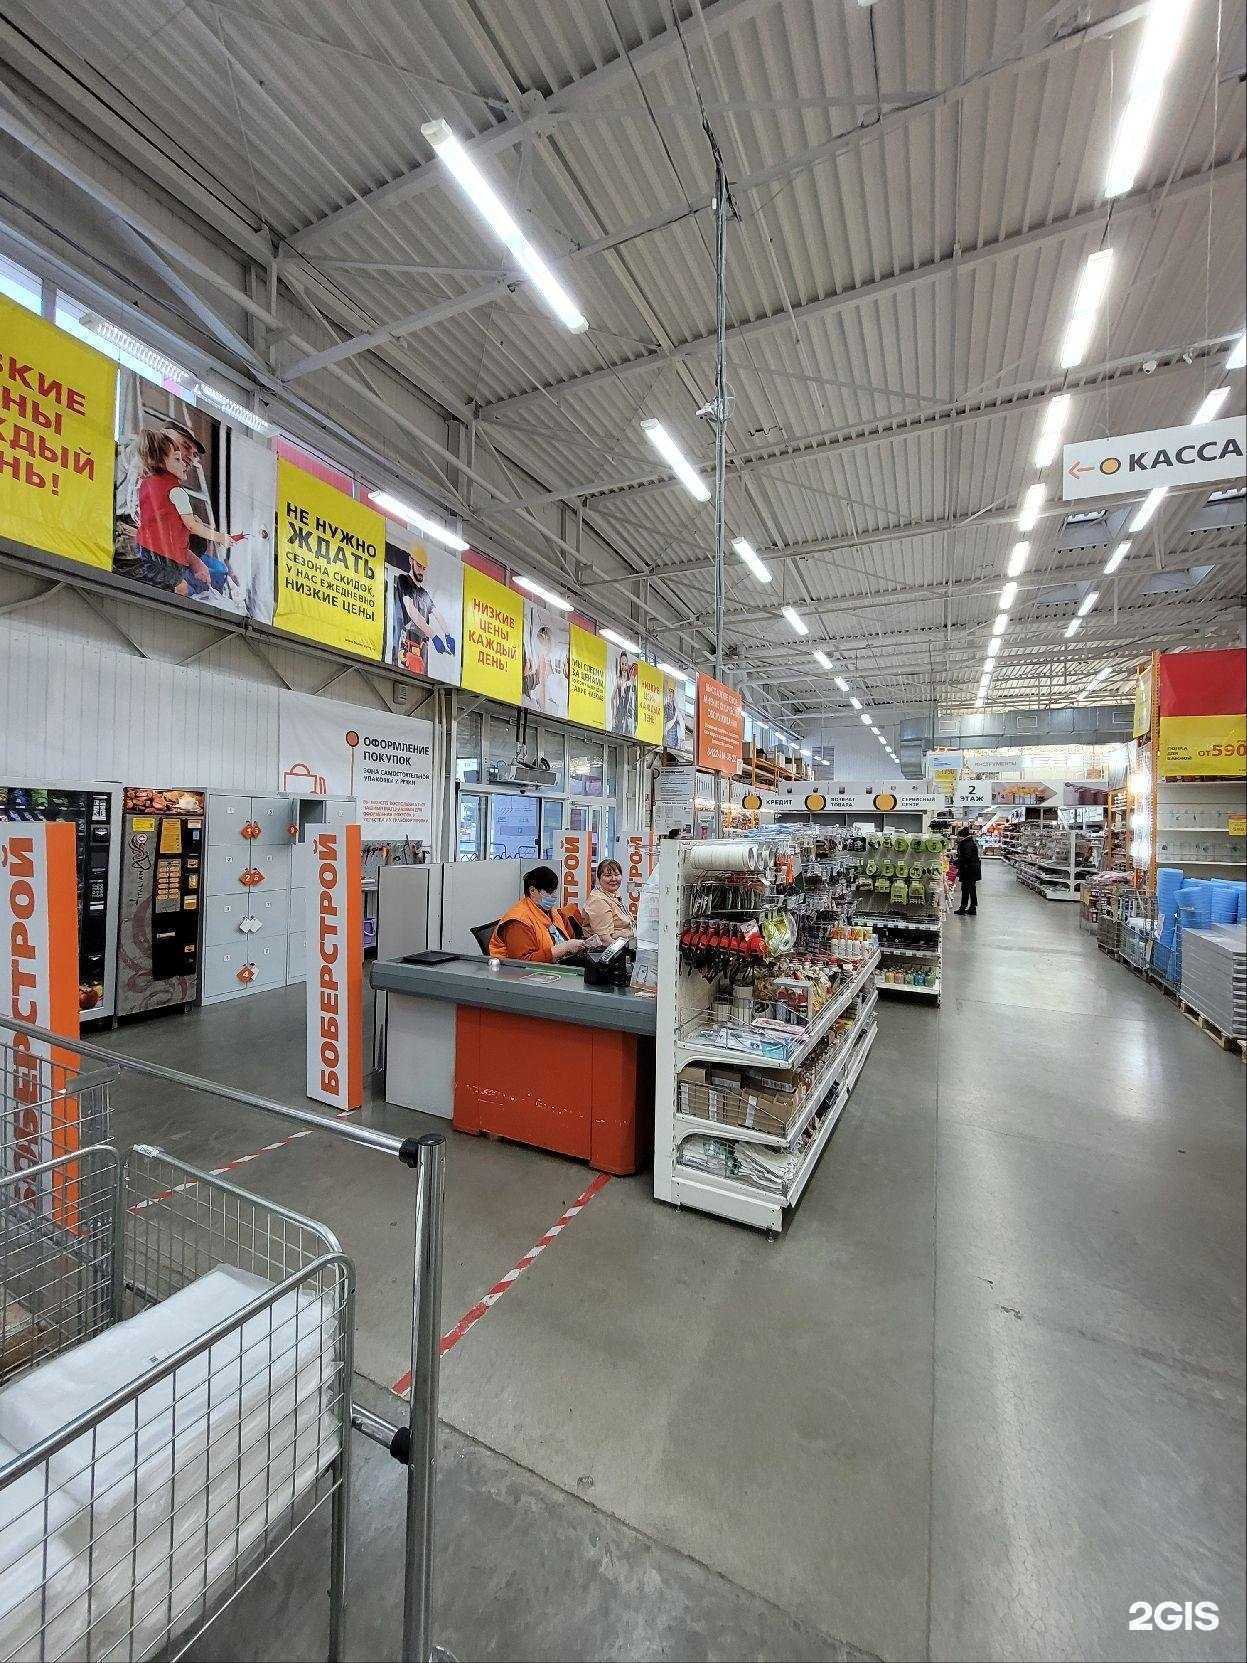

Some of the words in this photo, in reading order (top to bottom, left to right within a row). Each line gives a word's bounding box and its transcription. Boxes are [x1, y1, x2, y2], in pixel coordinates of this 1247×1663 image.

[1128, 438, 1244, 473] КАССА
[286, 501, 310, 527] НЕ
[315, 516, 377, 558] НУЖНО
[286, 520, 376, 581] ЖДАТЬ
[285, 550, 330, 578] СЕЗОНА
[333, 571, 376, 598] СКИДОК,
[285, 563, 293, 575] У
[296, 567, 318, 585] НАС
[320, 579, 376, 608] ЕЖЕДНЕВНО
[285, 577, 339, 608] НИЗКИЕ
[342, 599, 376, 622] ЦЕНЫ
[472, 598, 515, 629] НИЗКИЕ
[468, 629, 517, 660] КАЖДЫЙ
[479, 619, 509, 641] ЦЕНЫ
[477, 650, 508, 673] ДЕНЬ!
[363, 736, 430, 756] ОФОРМЛЕНИЕ
[363, 750, 412, 766] ПОКУПОК
[968, 785, 976, 795] 2
[242, 970, 250, 978] 4
[313, 833, 340, 1097] БОБЕРСТРОЙ
